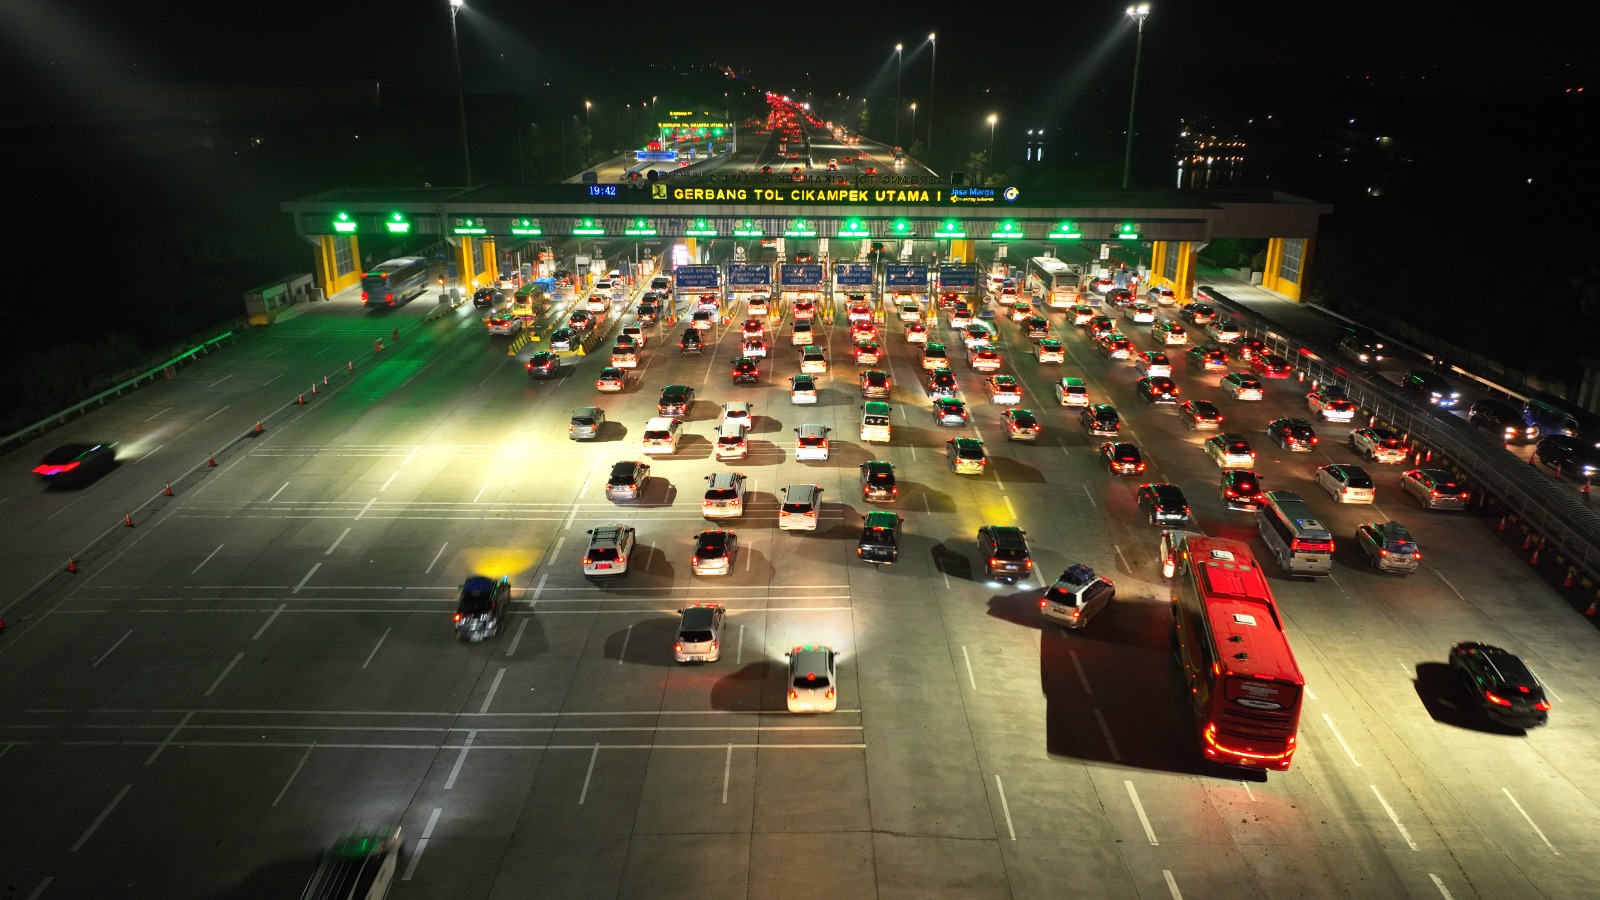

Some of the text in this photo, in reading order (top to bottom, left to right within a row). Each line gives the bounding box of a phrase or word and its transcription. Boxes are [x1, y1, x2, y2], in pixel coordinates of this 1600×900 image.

[590, 186, 616, 196] 19:42
[674, 188, 747, 200] GERBANG
[754, 189, 784, 200] TOL
[791, 190, 868, 201] CIKAMPEK
[876, 190, 930, 202] UTAMA
[970, 188, 994, 197] Marga
